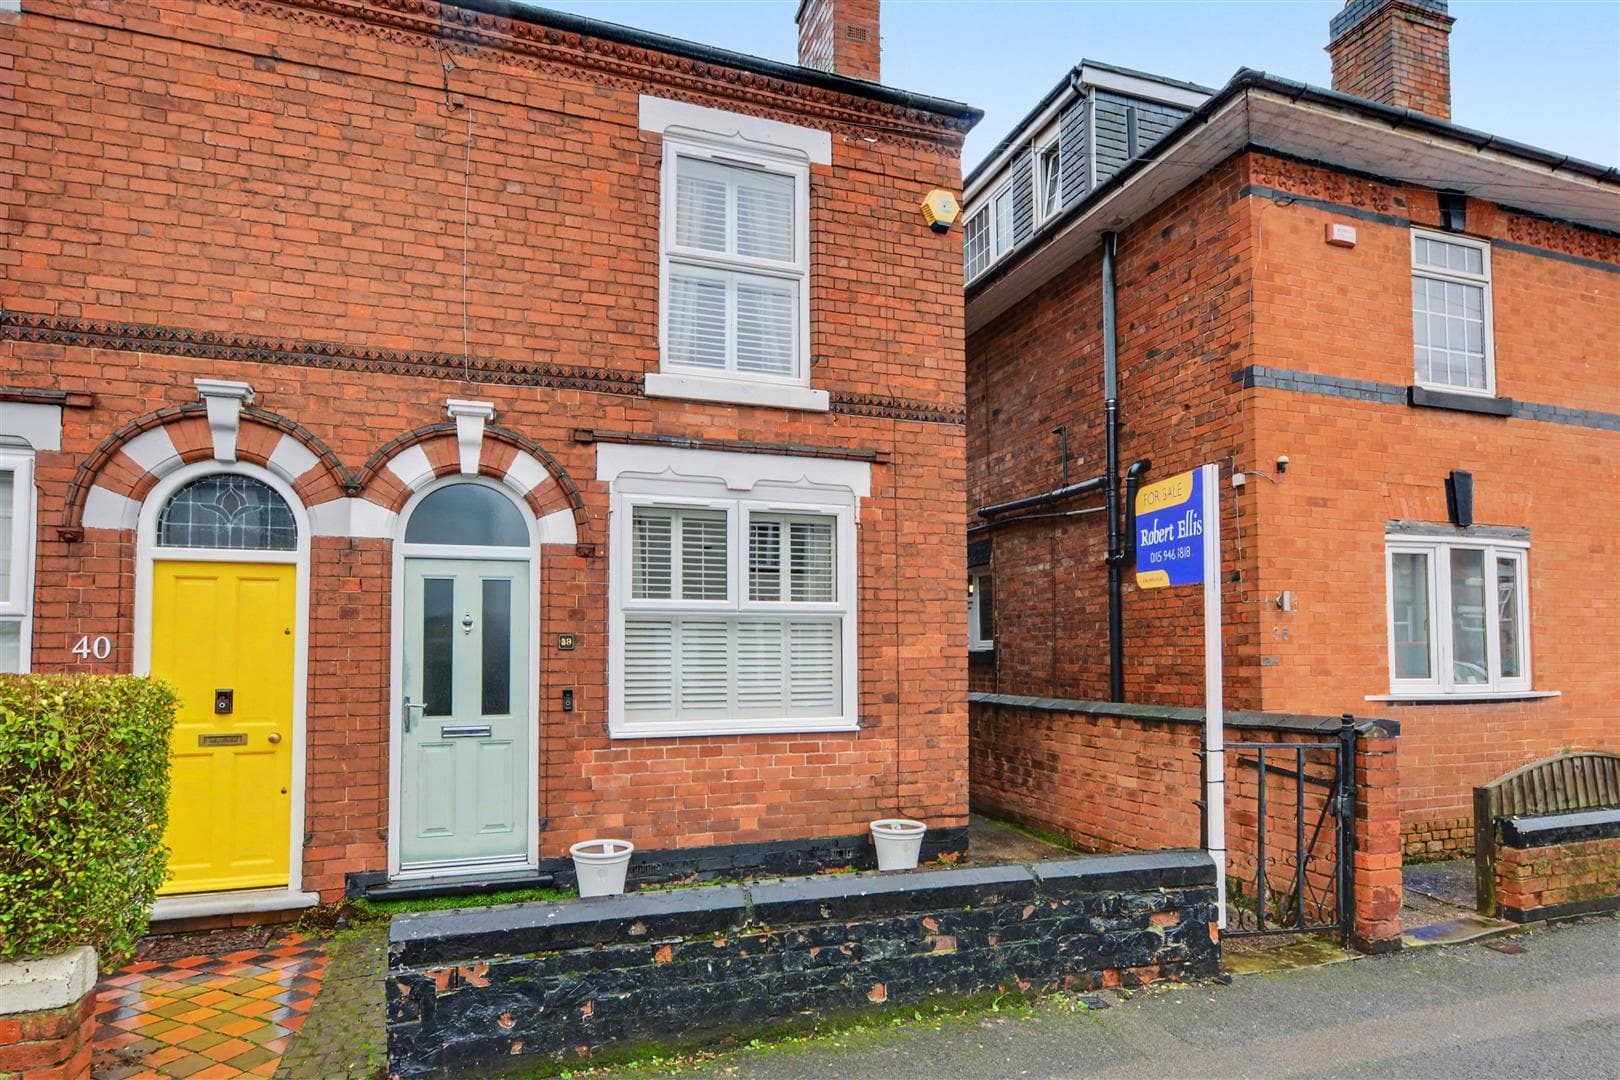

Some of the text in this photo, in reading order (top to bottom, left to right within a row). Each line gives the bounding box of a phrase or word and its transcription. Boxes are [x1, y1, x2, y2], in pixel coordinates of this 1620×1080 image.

[1143, 482, 1182, 506] FOR SALE
[1140, 509, 1203, 547] Robert Ellis
[1163, 549, 1176, 561] 946
[1177, 545, 1191, 559] 1818
[72, 635, 111, 659] 40
